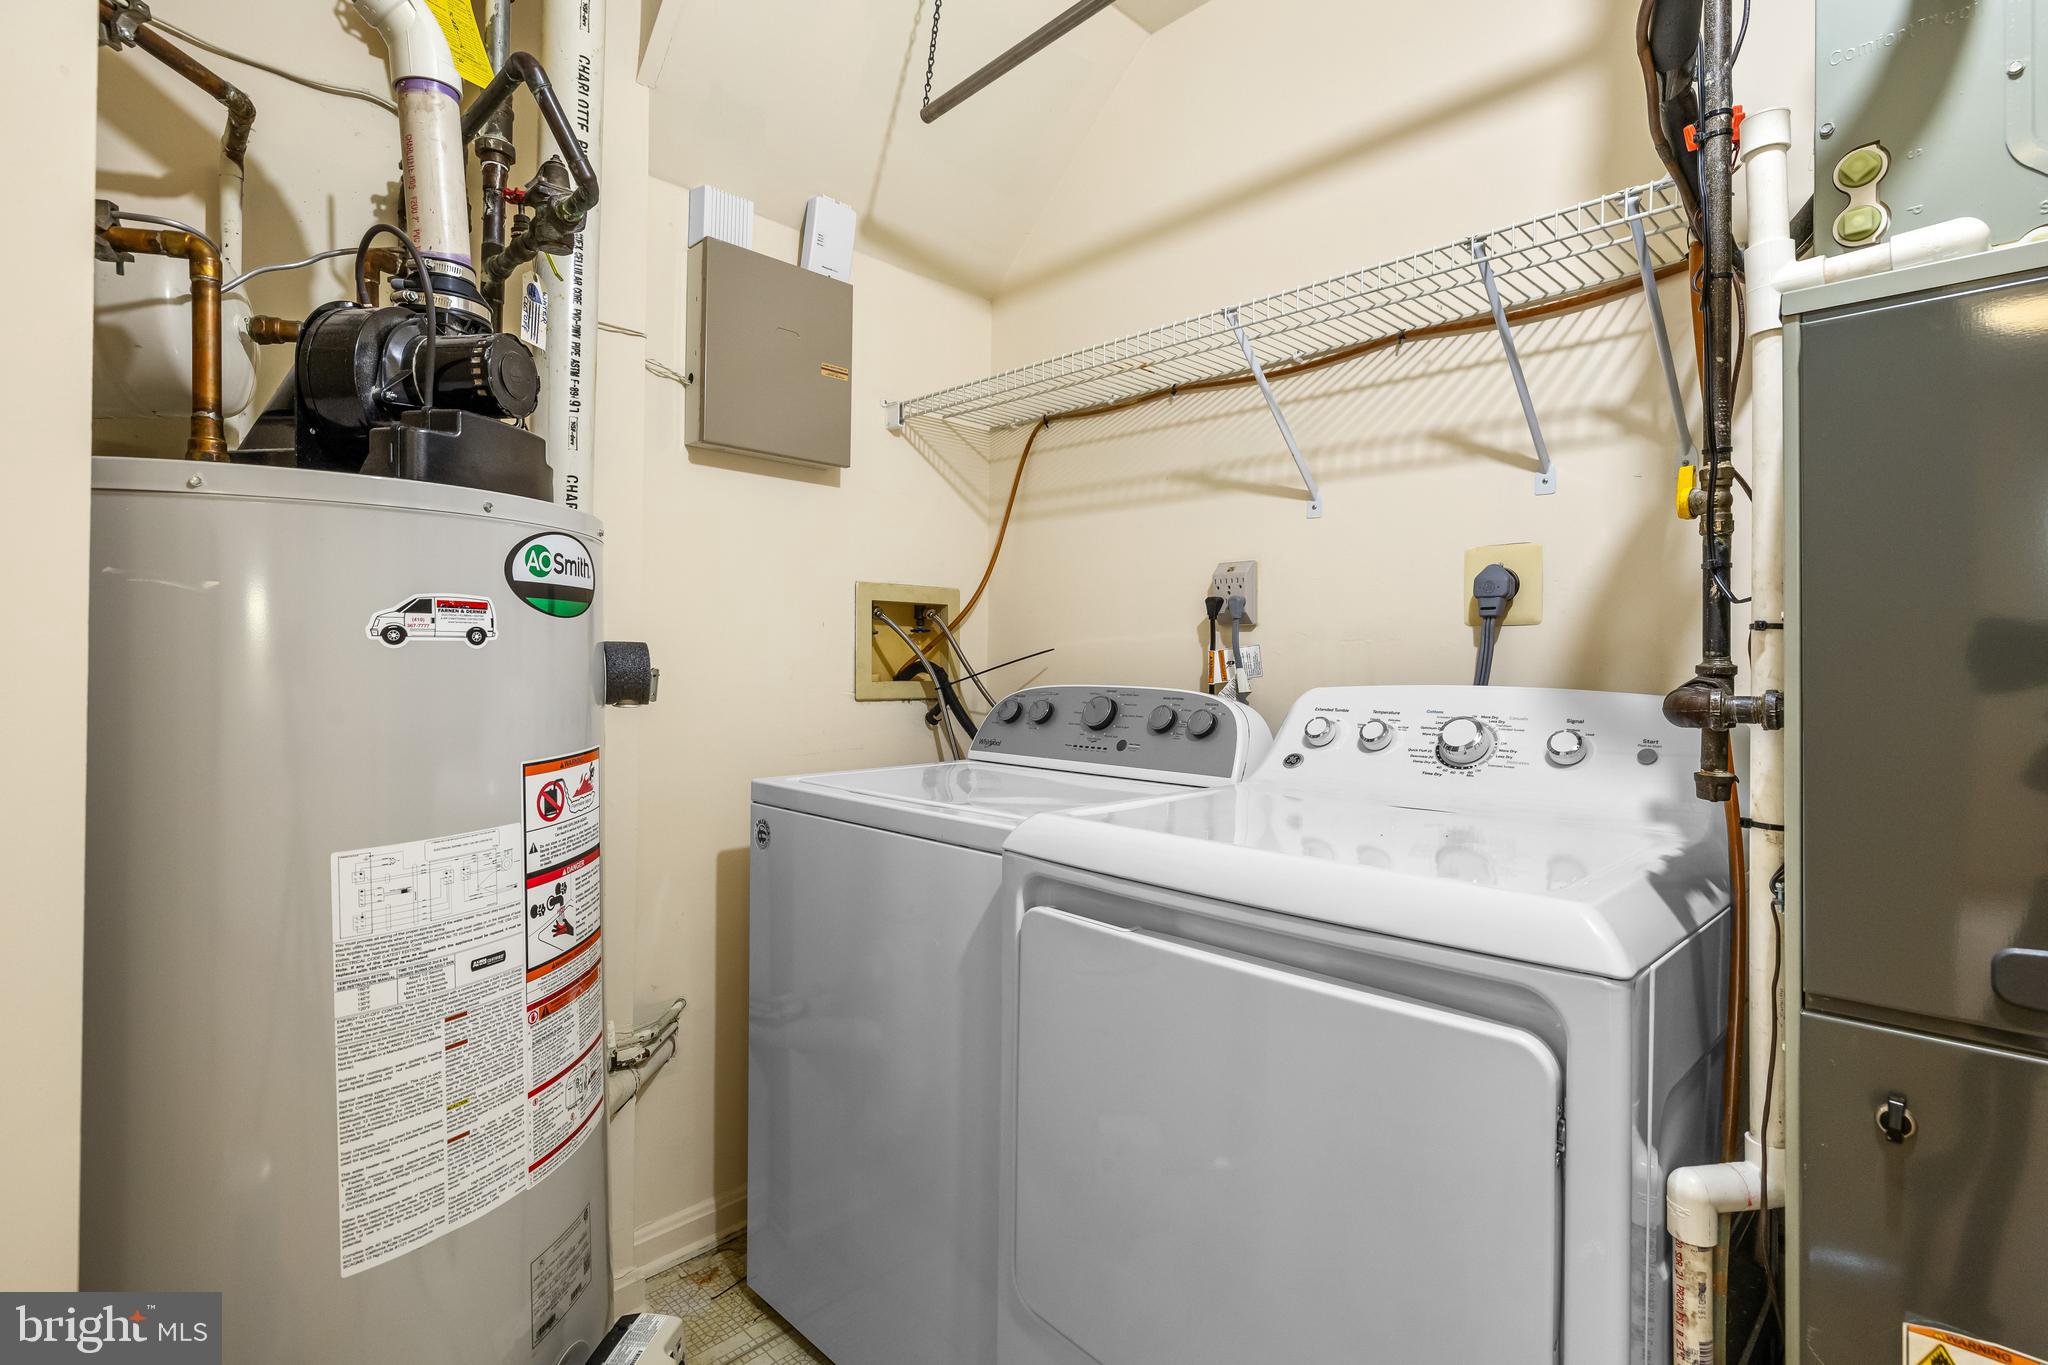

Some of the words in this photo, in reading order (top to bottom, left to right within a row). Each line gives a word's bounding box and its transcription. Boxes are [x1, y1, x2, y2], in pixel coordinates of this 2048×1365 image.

[573, 252, 583, 285] CELLULAR
[572, 288, 582, 304] CORE
[571, 342, 581, 357] PIPE
[570, 359, 581, 377] ASTM
[553, 552, 590, 578] Smith
[567, 859, 584, 873] DANGER
[1944, 1334, 2012, 1363] WARNING
